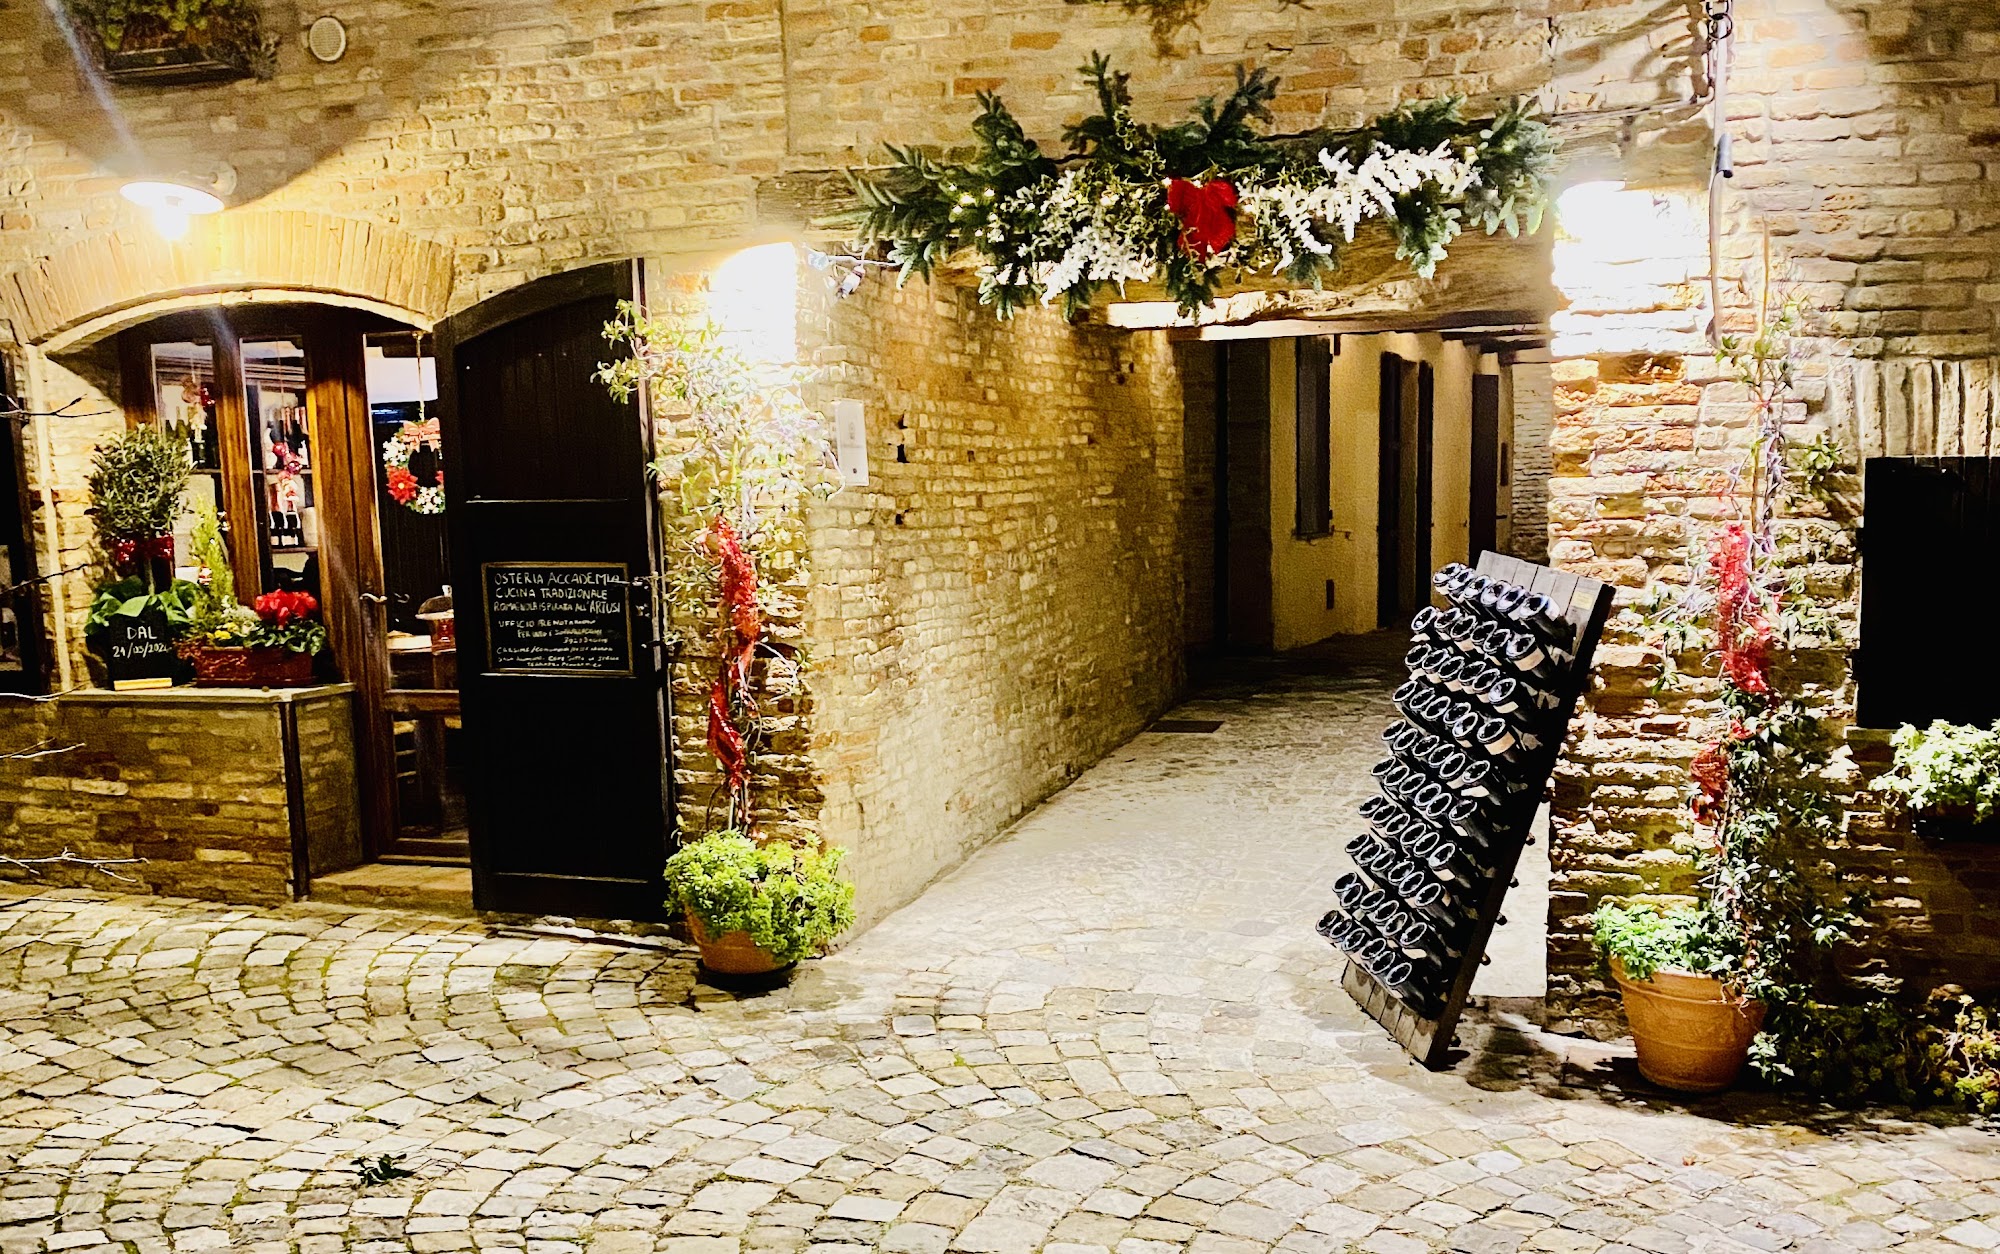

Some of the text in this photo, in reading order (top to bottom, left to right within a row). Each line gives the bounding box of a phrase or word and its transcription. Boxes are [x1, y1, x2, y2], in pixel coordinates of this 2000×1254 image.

[494, 572, 620, 586] OSTERIA ACCADEMIA
[495, 587, 608, 600] CUCINA TRADIZIONALE
[498, 620, 535, 628] UFFICIO
[126, 625, 158, 640] DAL
